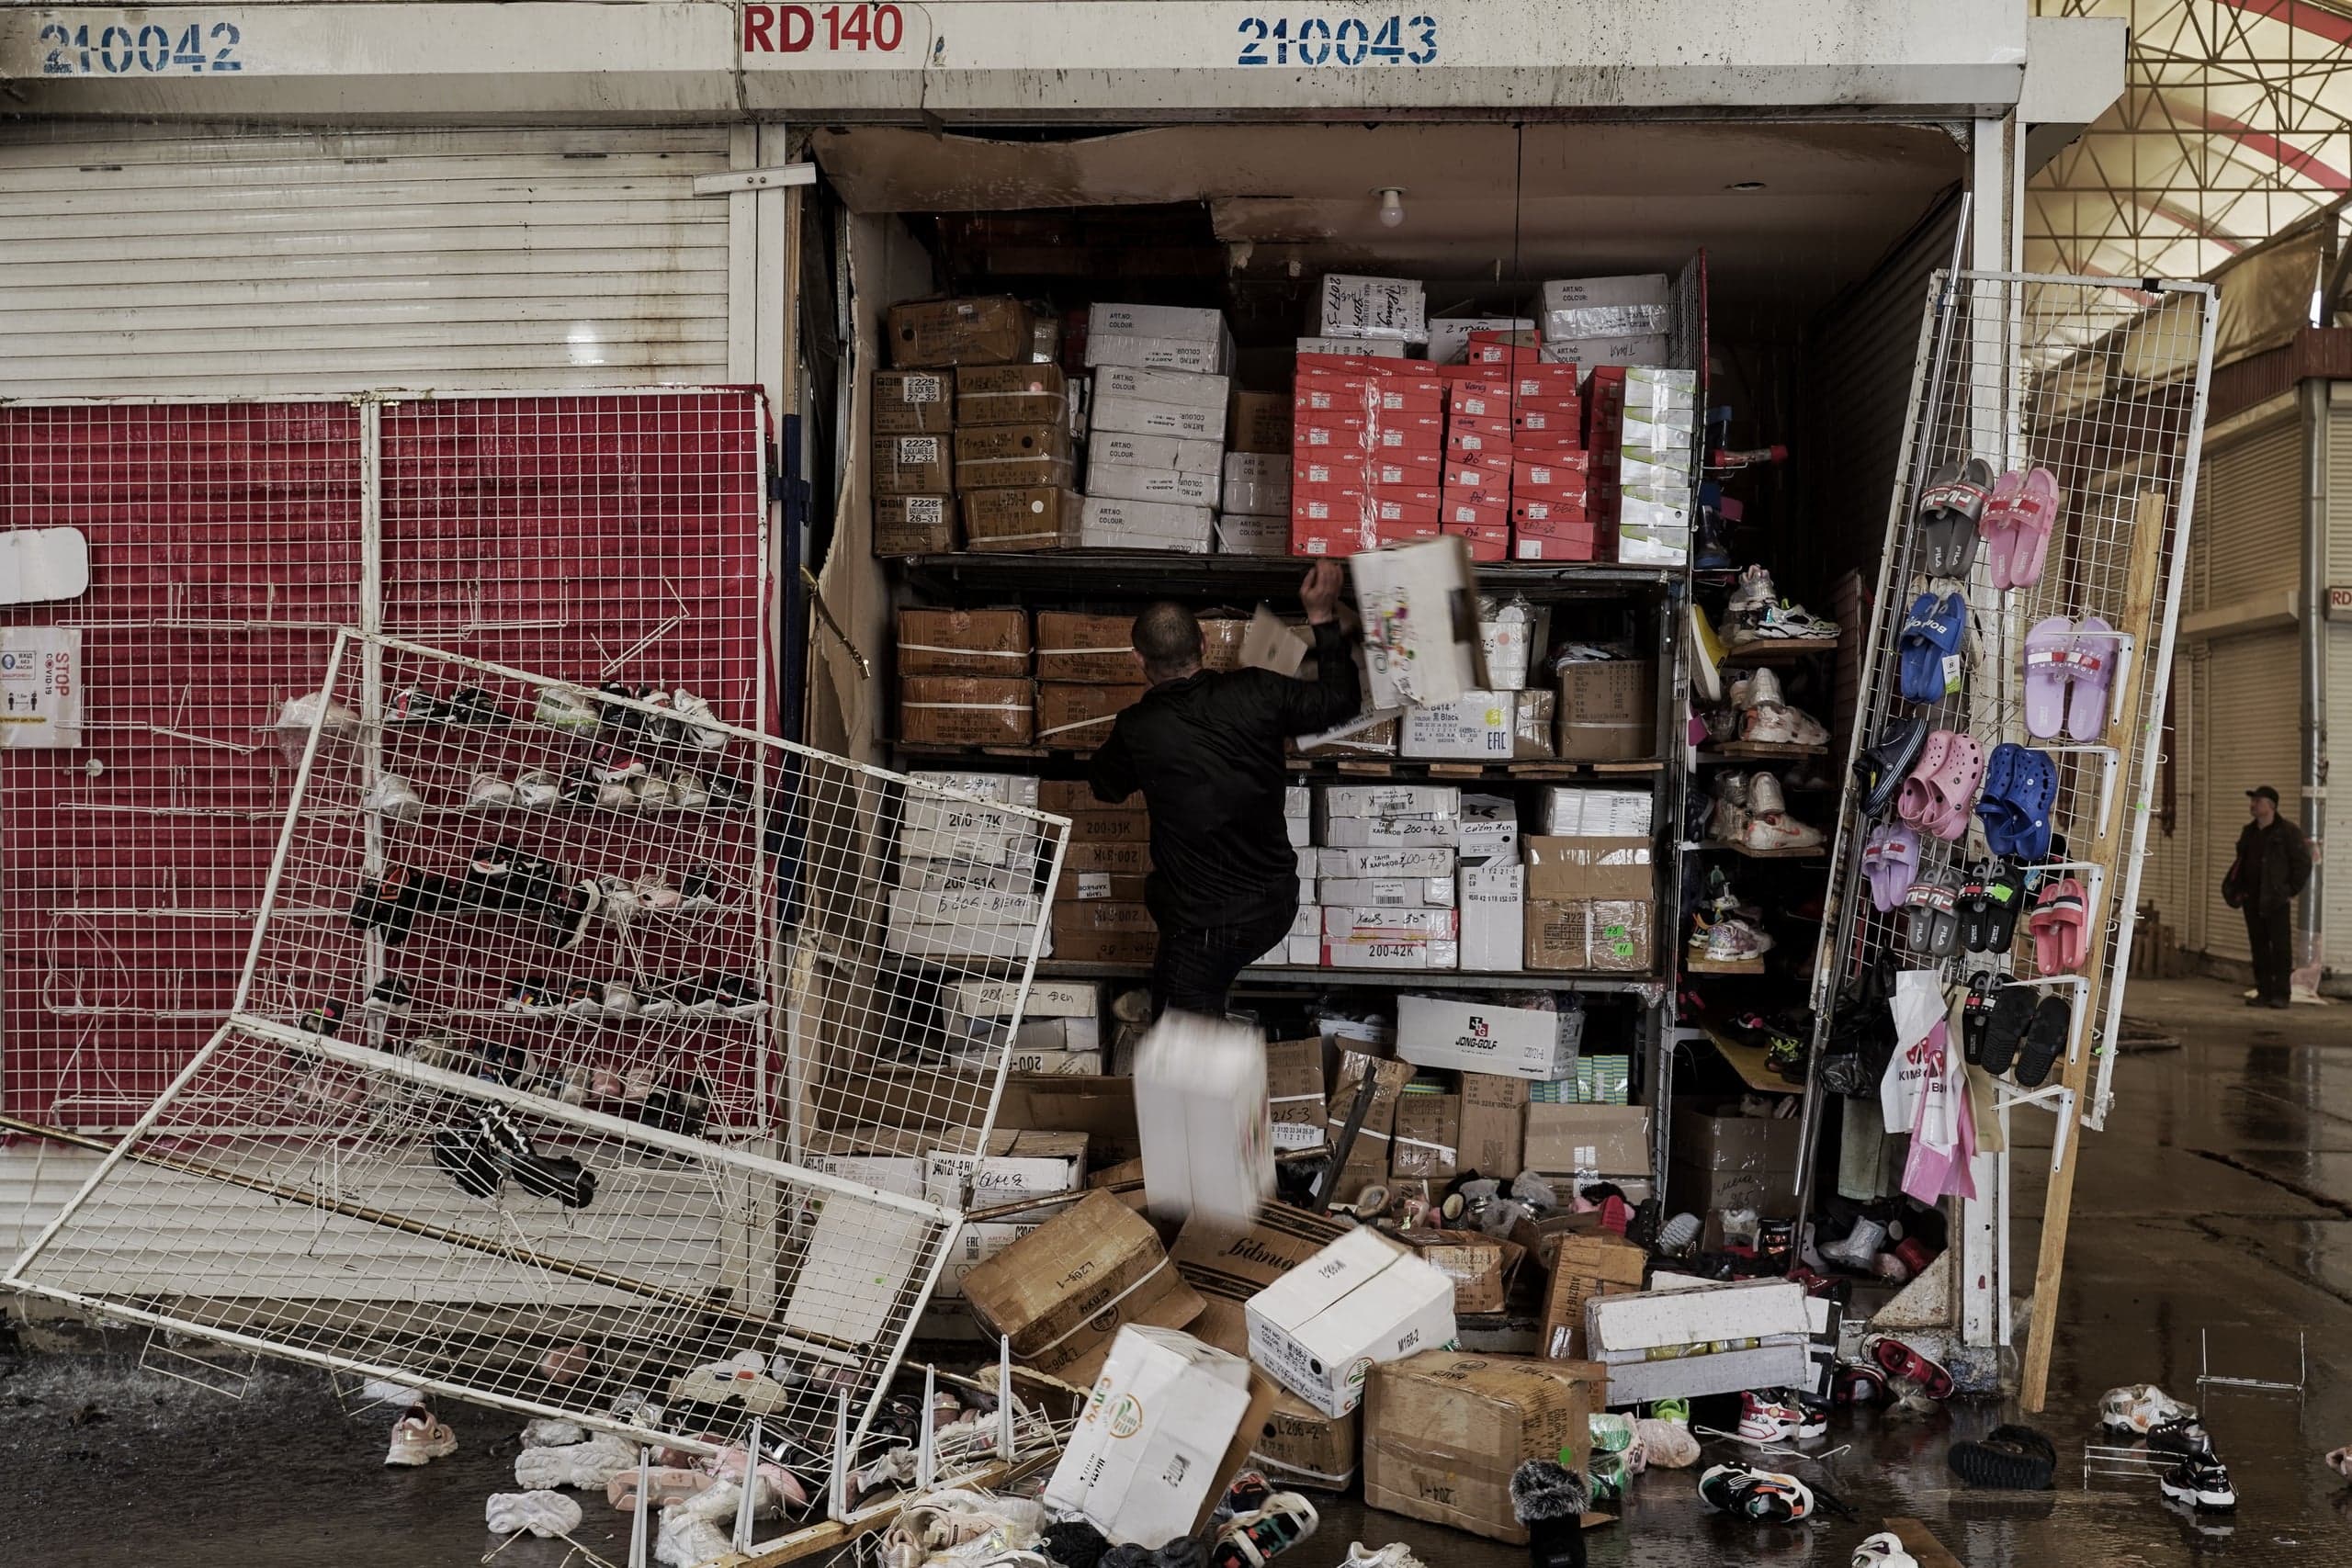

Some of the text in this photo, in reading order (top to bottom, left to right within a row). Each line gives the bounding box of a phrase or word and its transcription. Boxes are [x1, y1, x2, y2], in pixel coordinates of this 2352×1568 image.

[1952, 545, 1962, 566] FILA
[55, 652, 70, 696] STOP
[1487, 732, 1507, 750] EAC
[1937, 925, 1948, 946] FILA
[1368, 945, 1414, 958] 200-42K
[1455, 1036, 1498, 1050] JONG-GOLF
[966, 1236, 980, 1247] EAC
